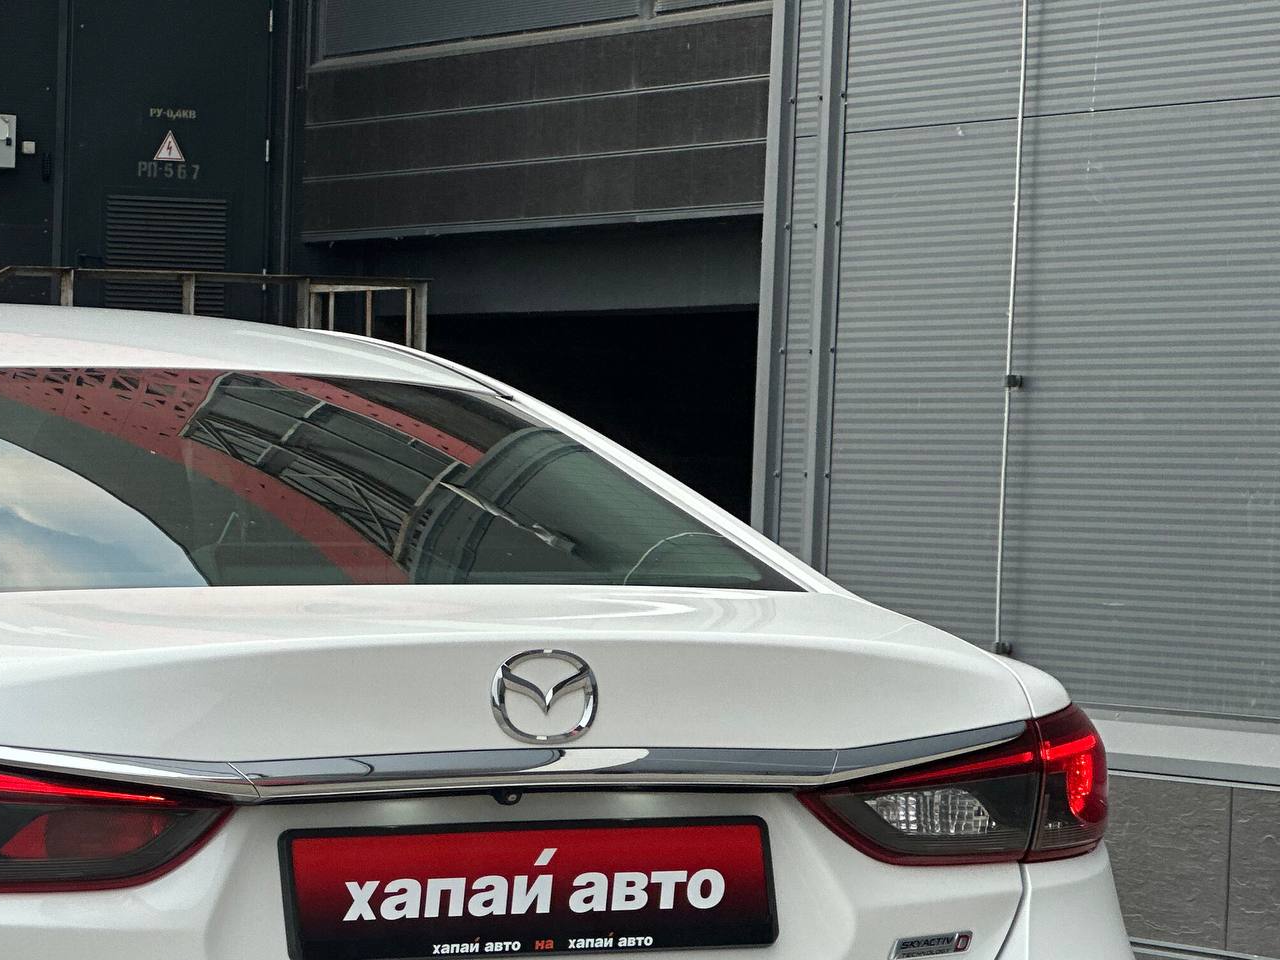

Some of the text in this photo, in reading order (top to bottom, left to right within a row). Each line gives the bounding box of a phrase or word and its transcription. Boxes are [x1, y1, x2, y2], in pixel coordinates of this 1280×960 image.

[568, 868, 726, 914] авто
[484, 940, 522, 953] авто
[534, 939, 554, 951] на
[617, 935, 654, 948] авто
